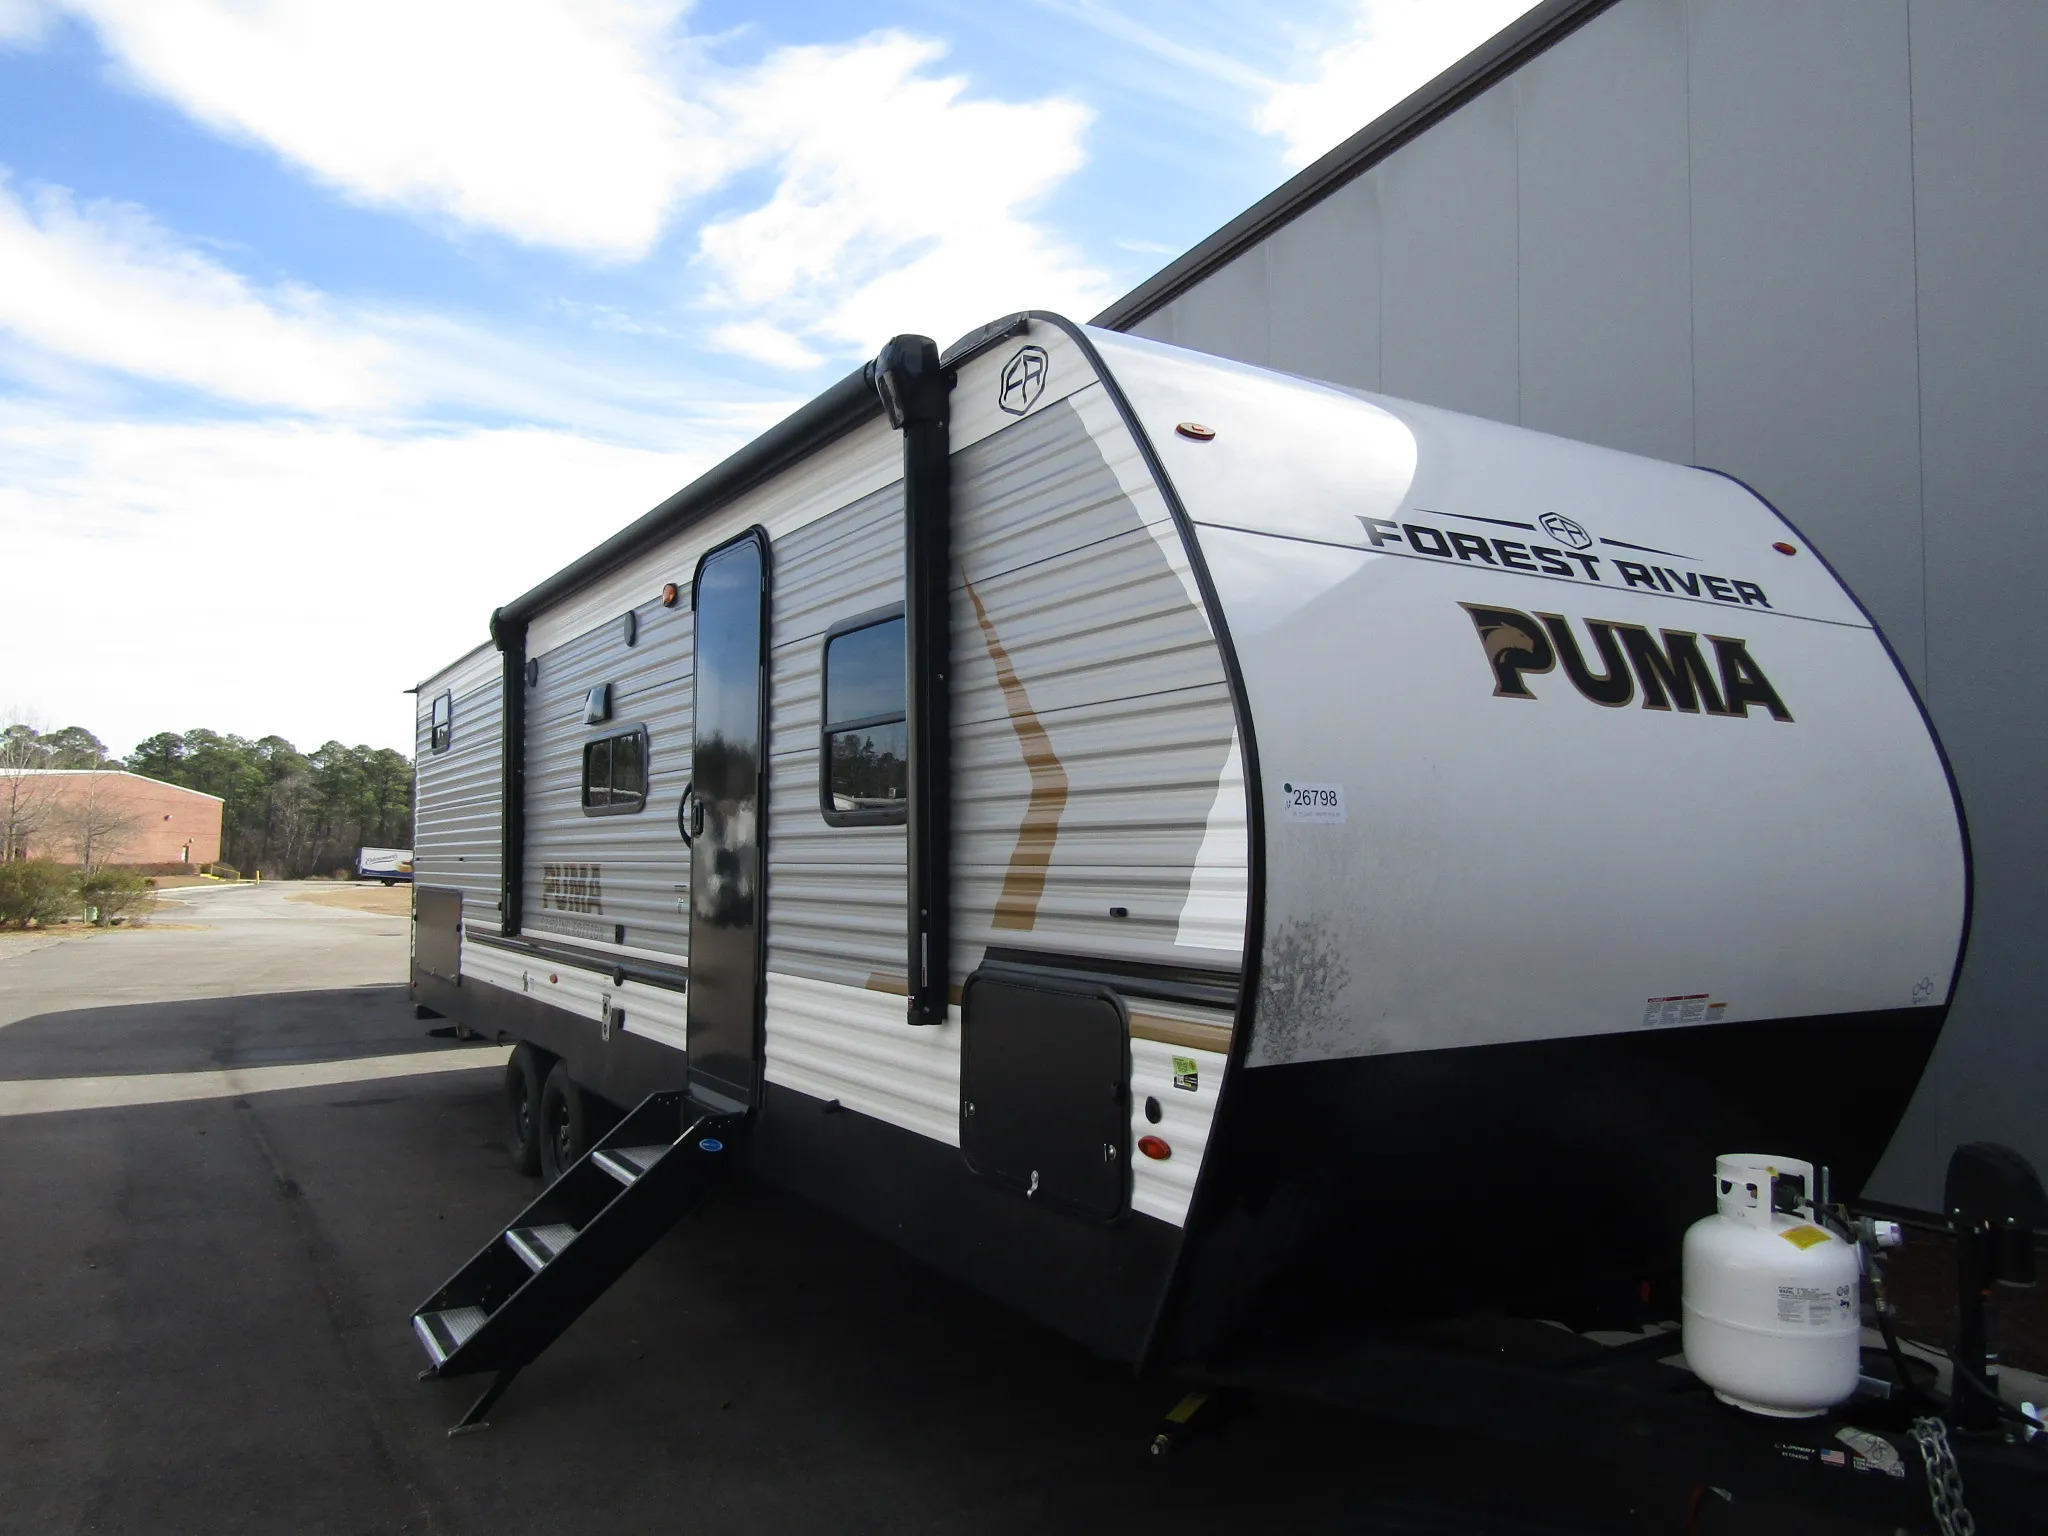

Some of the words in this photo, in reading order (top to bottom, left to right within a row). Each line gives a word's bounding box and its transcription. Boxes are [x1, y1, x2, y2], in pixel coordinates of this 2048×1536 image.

[1354, 515, 1600, 581] FOREST
[1611, 559, 1773, 609] RIVER
[1456, 601, 1796, 723] PUMA
[1293, 789, 1338, 806] 26798
[543, 863, 603, 915] PUMA
